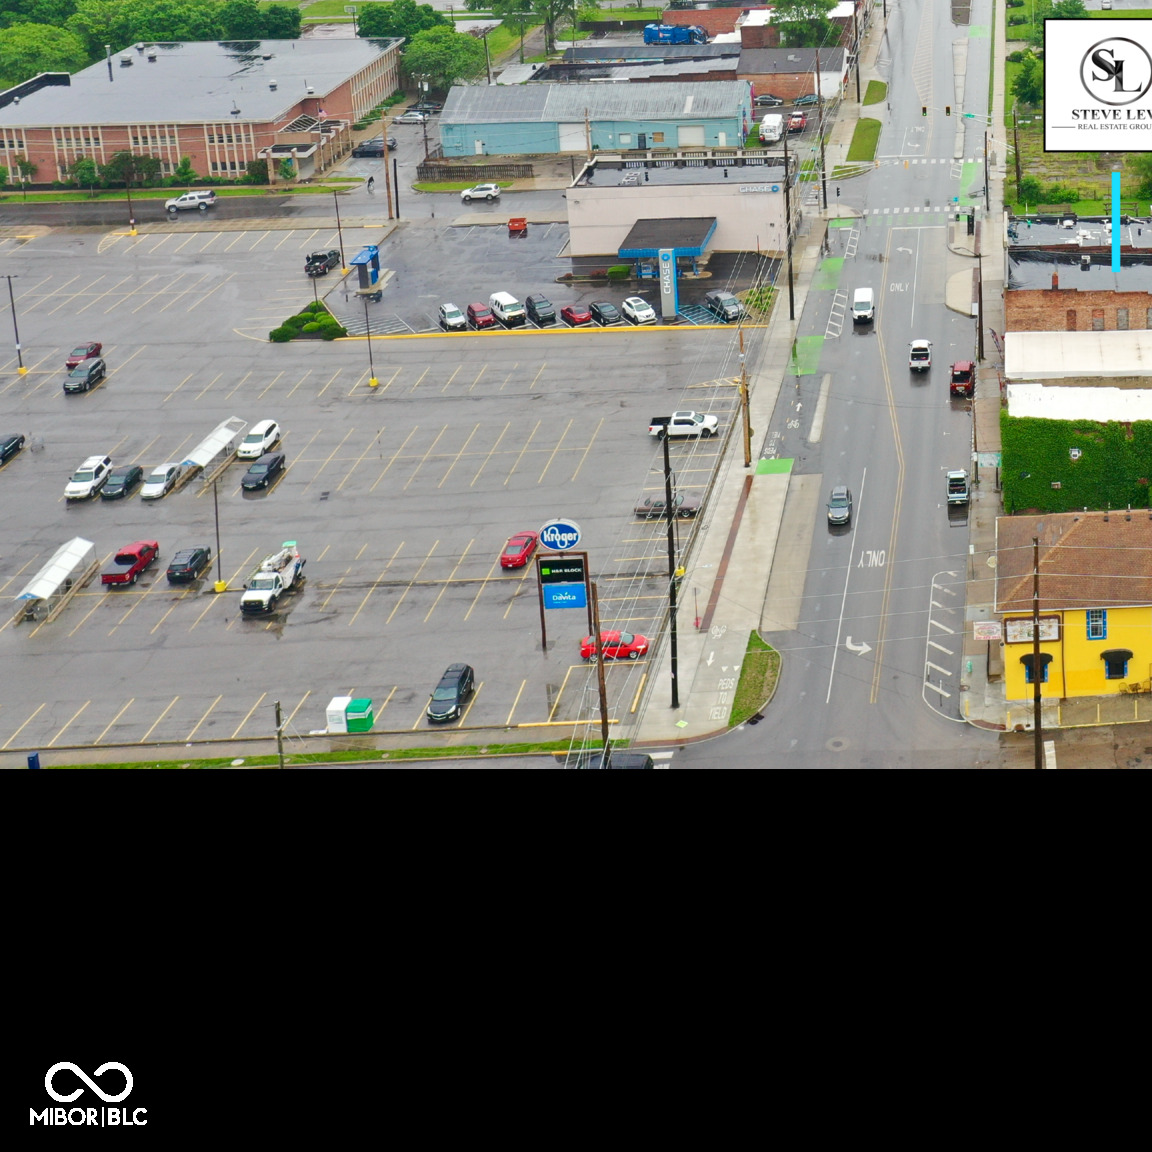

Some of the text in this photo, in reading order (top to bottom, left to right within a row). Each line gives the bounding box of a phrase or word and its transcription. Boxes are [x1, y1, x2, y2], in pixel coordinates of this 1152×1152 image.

[739, 185, 770, 193] CHASE
[662, 262, 671, 294] CHASE
[890, 282, 909, 292] ONLY
[543, 526, 578, 549] Kroger
[857, 549, 886, 568] ONLY
[717, 677, 735, 689] PEDS
[718, 691, 728, 704] TO
